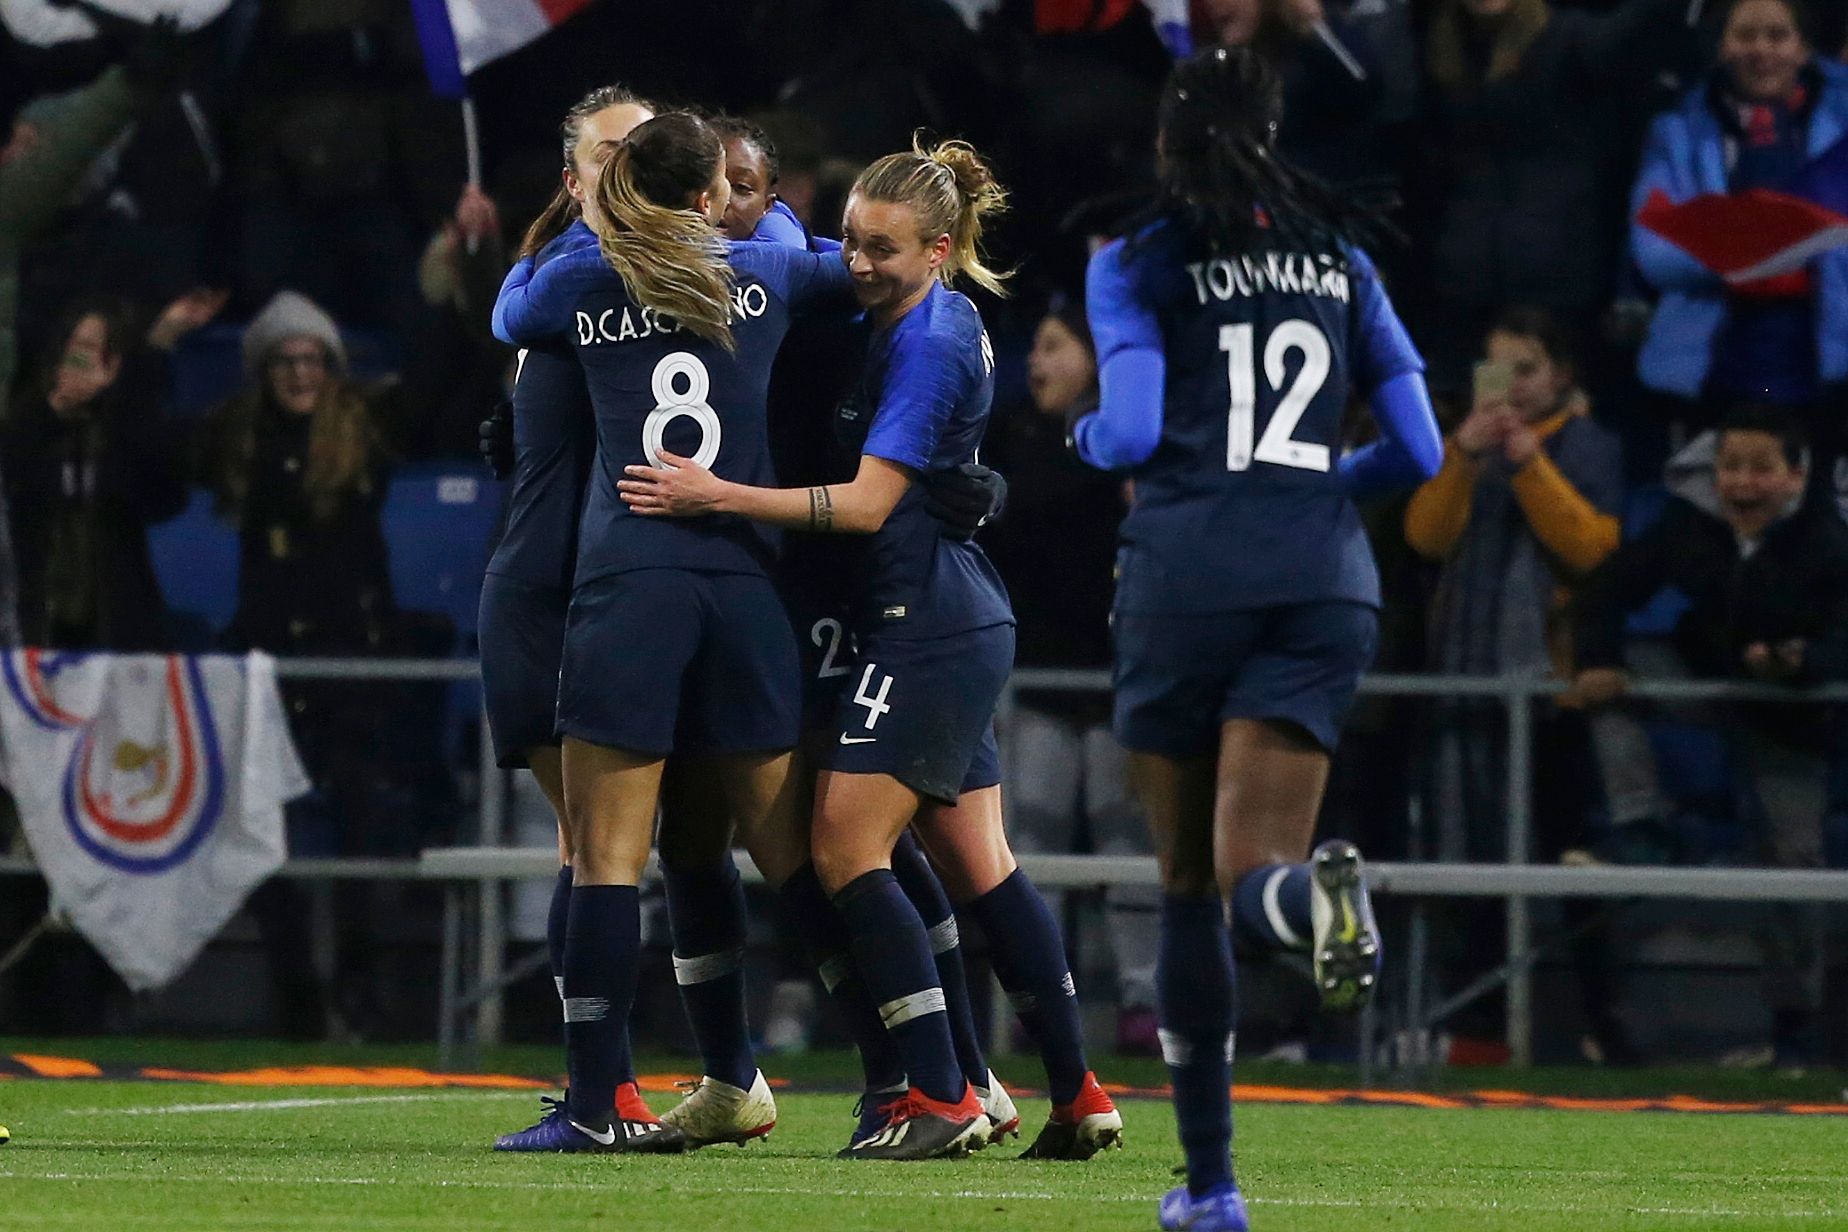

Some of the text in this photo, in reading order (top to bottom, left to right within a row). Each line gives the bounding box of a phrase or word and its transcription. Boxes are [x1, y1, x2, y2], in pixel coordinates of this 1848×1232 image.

[576, 283, 768, 346] D.CASCNO
[642, 351, 721, 471] 8
[1219, 318, 1331, 473] 12
[811, 617, 859, 680] 2
[853, 663, 894, 730] 4
